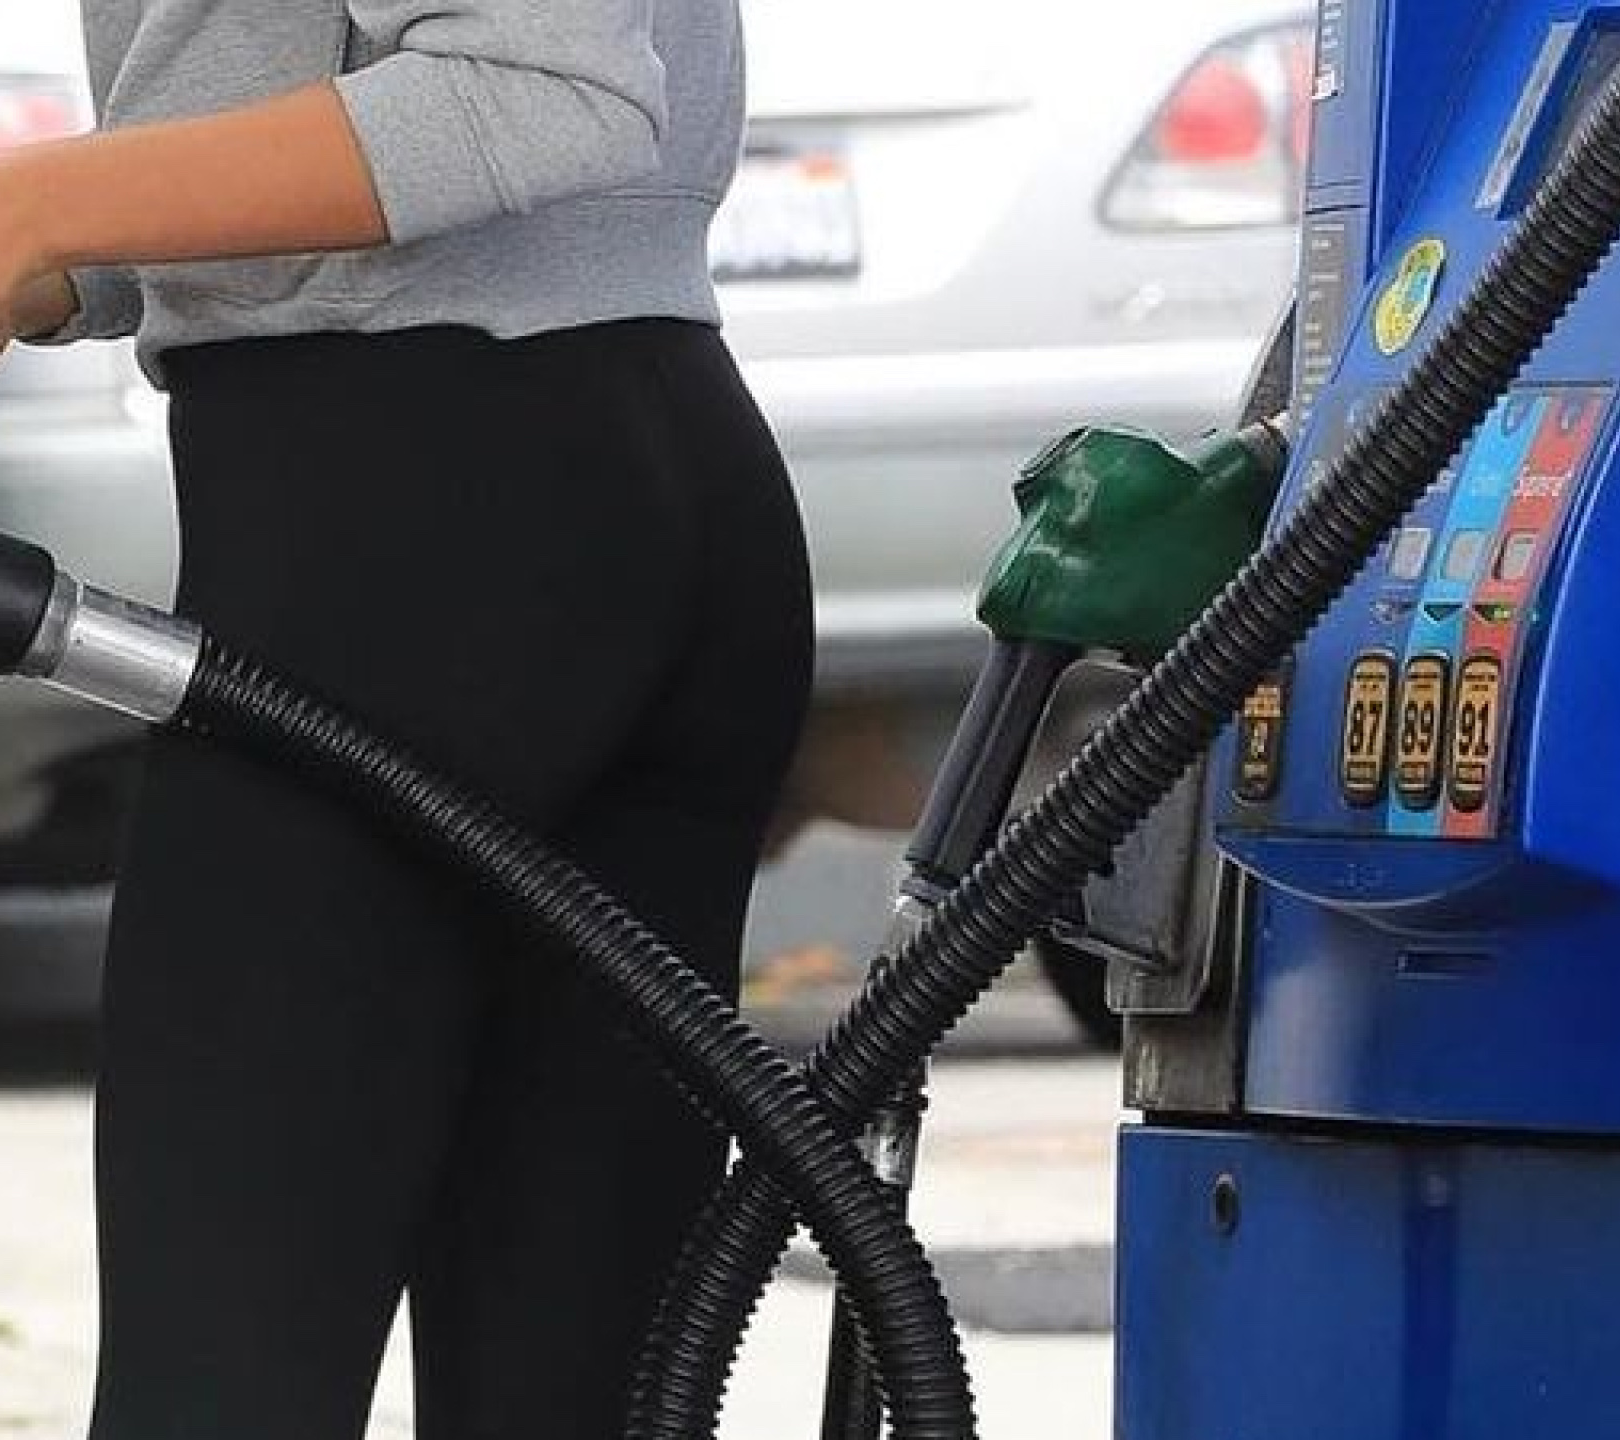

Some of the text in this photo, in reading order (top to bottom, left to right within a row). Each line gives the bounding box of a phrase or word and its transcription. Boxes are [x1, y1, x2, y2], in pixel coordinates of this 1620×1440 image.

[1350, 700, 1383, 756] 87
[1401, 700, 1434, 756] 89
[1458, 700, 1489, 756] 91
